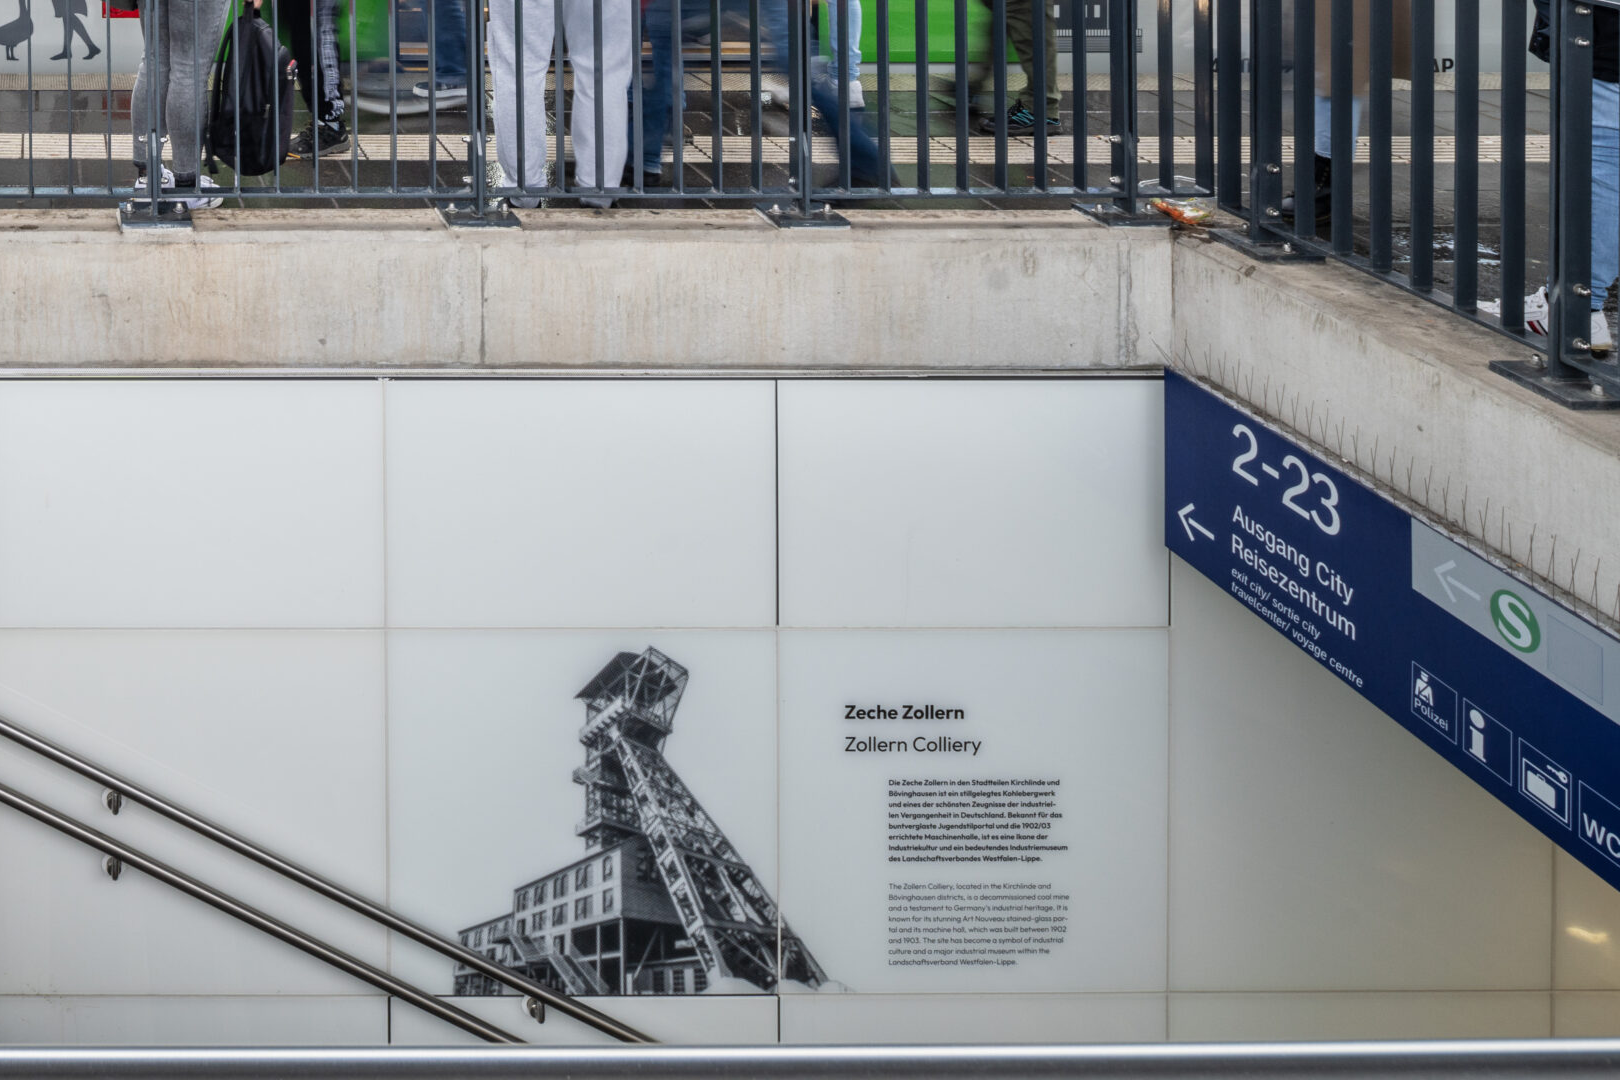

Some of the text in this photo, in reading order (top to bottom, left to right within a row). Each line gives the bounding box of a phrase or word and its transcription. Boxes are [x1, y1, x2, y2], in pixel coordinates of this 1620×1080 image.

[1232, 424, 1341, 536] 2-23
[1232, 505, 1355, 606] Ausgang City
[1232, 533, 1356, 641] Reisezentrum
[1231, 568, 1321, 640] exit city/ sortie city
[1497, 593, 1532, 648] S
[1231, 581, 1363, 688] travelcenter/ voyage centre
[844, 704, 965, 720] Zeche Zollern
[1414, 697, 1449, 732] Polizei
[844, 736, 982, 756] Zollern Colliery
[888, 790, 937, 798] Bövinghausen
[960, 790, 1002, 798] stillgelegtes
[1002, 790, 1055, 798] Kohlebergwerk
[971, 801, 1006, 809] Zeugnisse
[900, 811, 952, 820] Vergangenheit
[888, 822, 937, 831] buntverglaste
[938, 822, 995, 831] Jugendstilportal
[1022, 822, 1051, 831] 1902/03
[1583, 812, 1620, 859] WC
[888, 893, 936, 902] Bövinghausen
[953, 904, 991, 913] Germany's
[933, 915, 962, 924] stunning
[1006, 915, 1052, 924] stained-glass
[998, 936, 1023, 945] symbol
[933, 947, 954, 956] major
